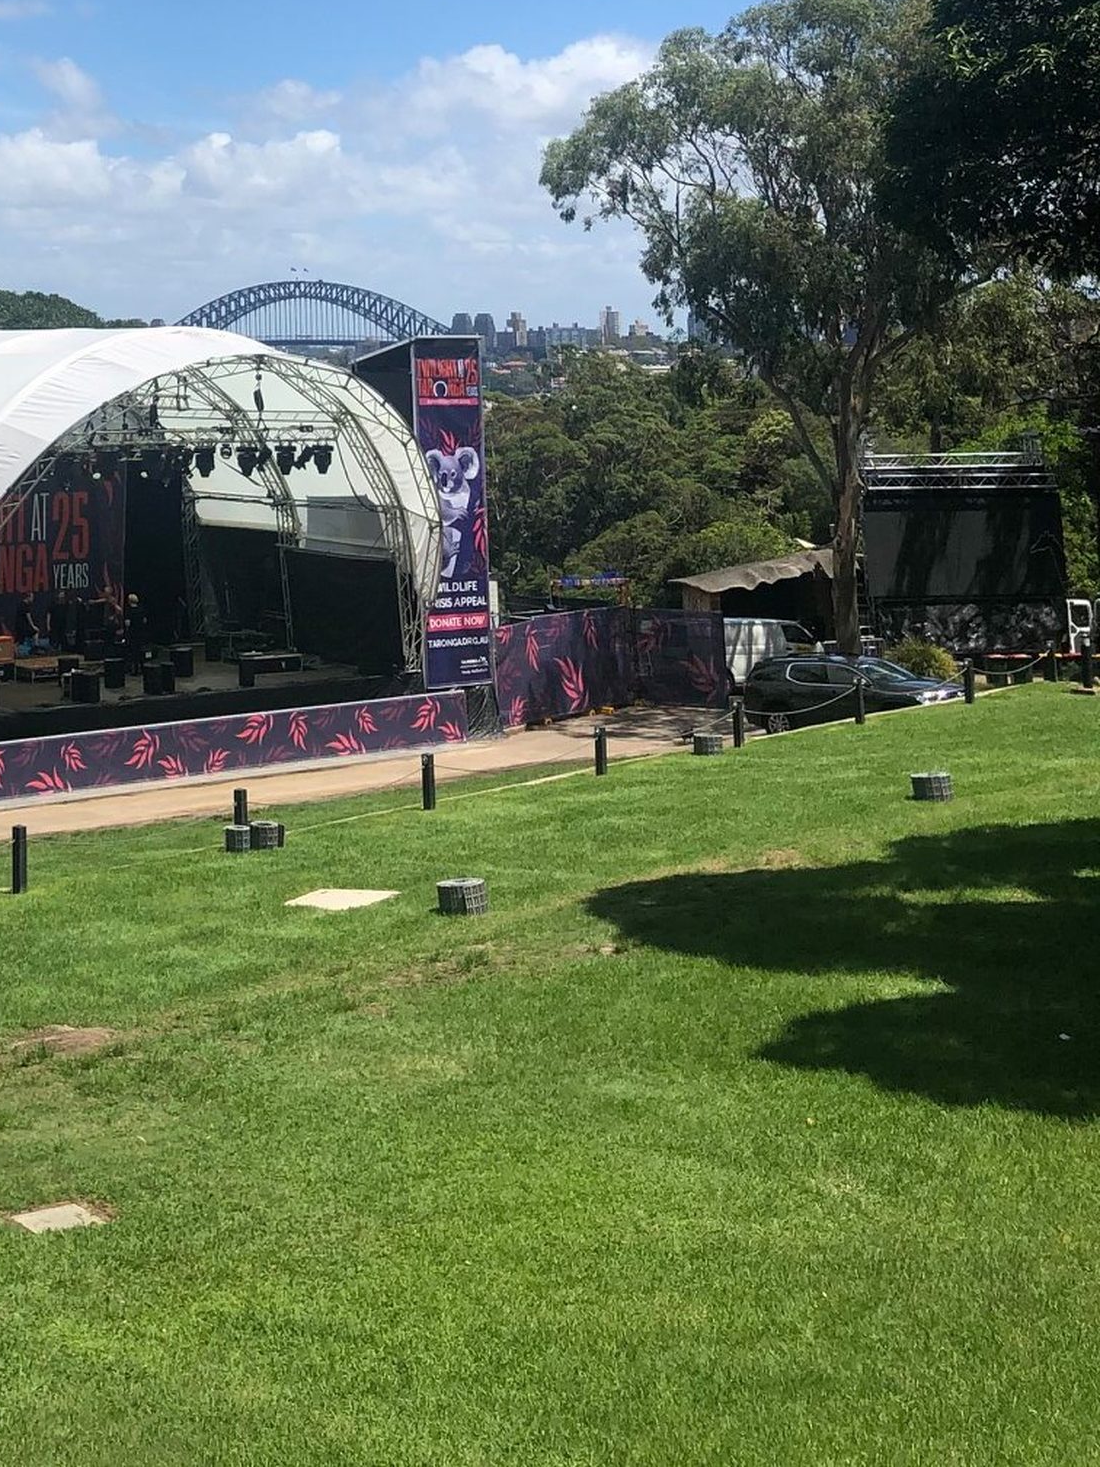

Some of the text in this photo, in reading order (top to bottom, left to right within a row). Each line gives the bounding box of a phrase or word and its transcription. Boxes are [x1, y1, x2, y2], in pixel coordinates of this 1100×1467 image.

[31, 492, 50, 542] AT
[51, 490, 91, 561] 25
[53, 562, 90, 590] YEARS
[453, 595, 487, 607] APPEAL
[429, 615, 485, 629] DONATE NOW
